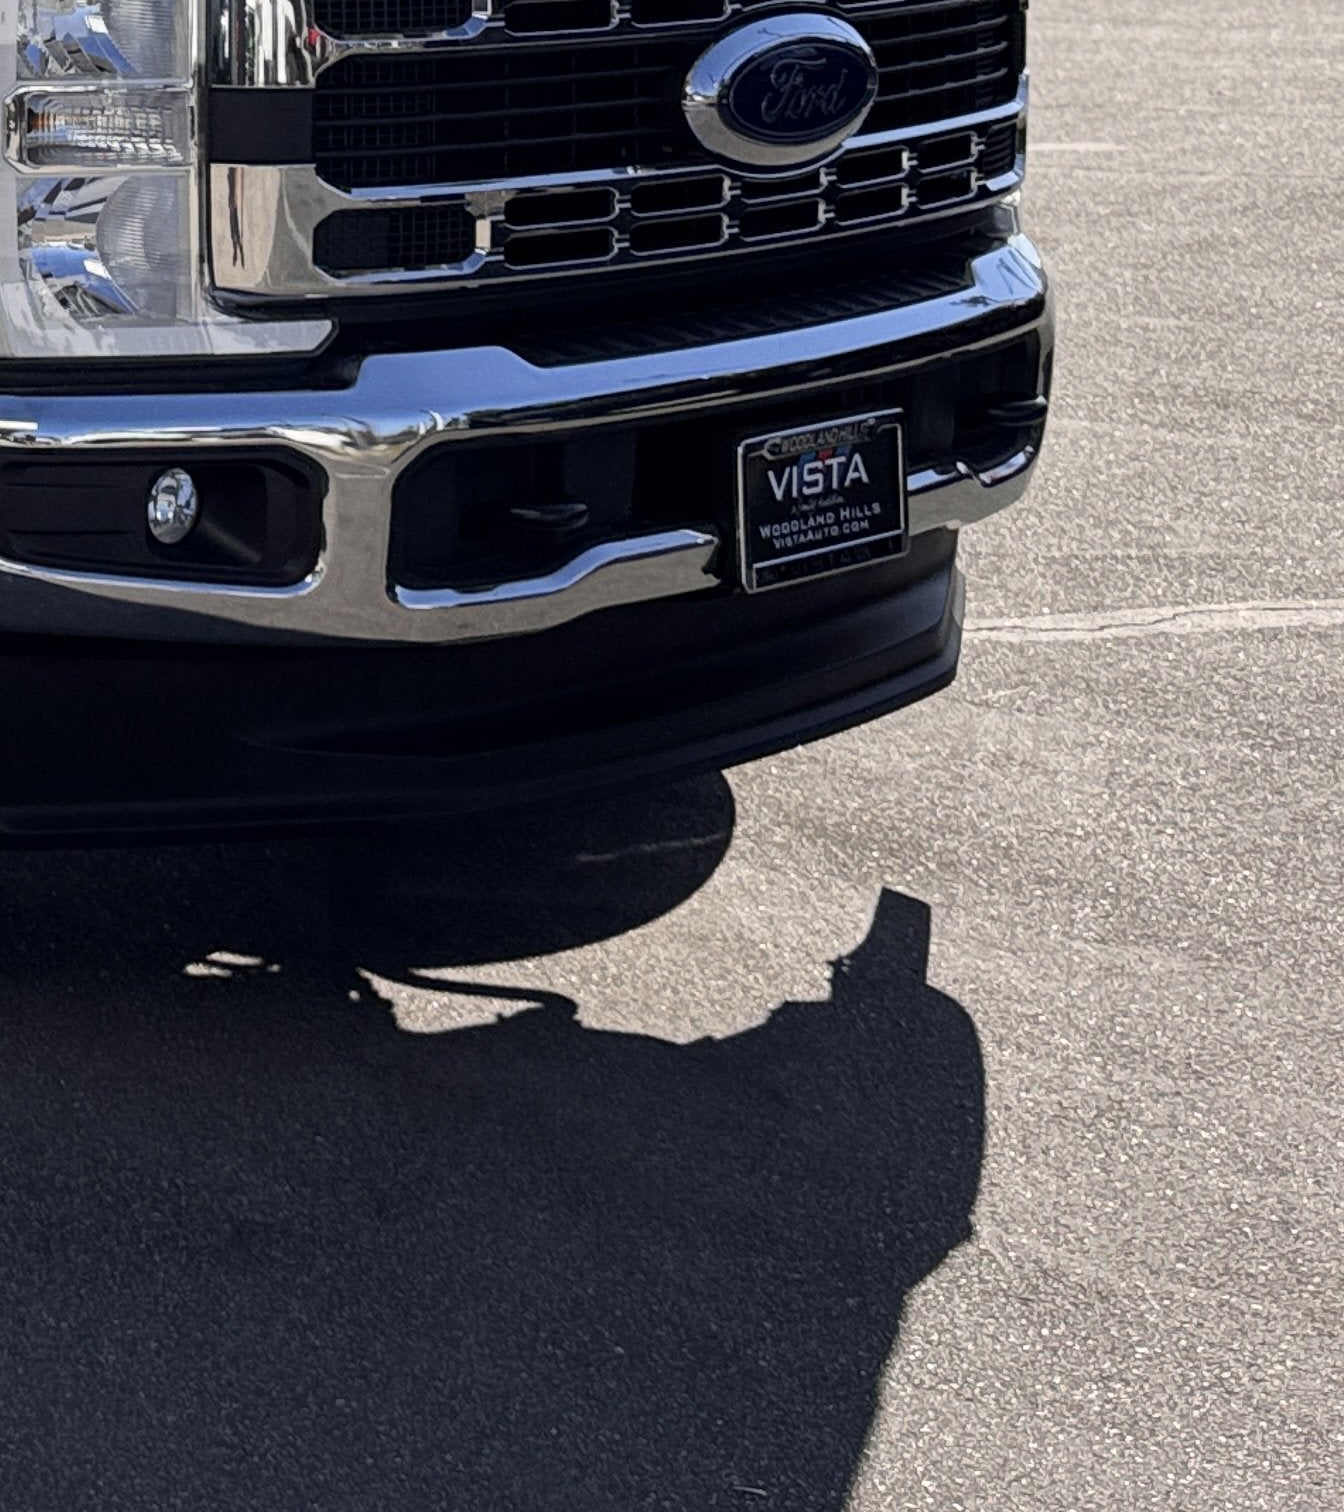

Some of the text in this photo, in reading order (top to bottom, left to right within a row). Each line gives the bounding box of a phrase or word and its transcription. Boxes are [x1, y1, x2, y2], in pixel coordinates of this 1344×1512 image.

[760, 57, 849, 124] Ford
[767, 452, 870, 502] VISTA
[840, 502, 881, 522] HILLS
